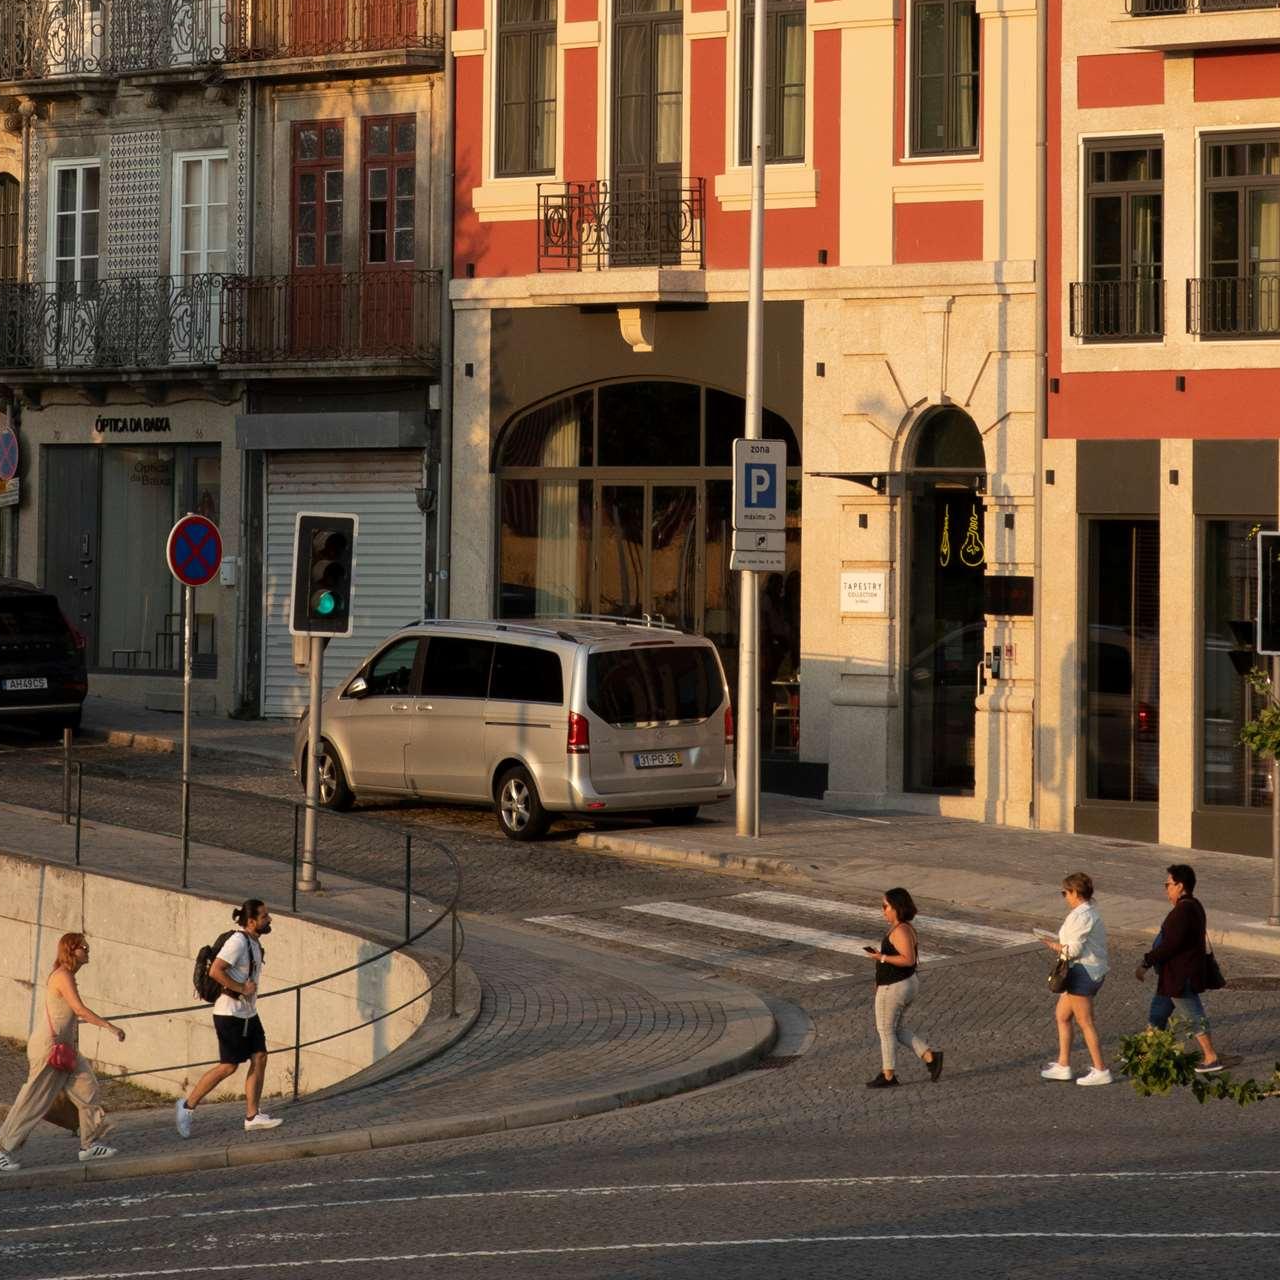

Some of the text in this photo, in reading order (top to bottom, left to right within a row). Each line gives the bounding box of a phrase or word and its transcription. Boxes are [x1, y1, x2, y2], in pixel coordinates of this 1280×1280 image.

[95, 415, 171, 433] ÓPTICA DA BAIXA
[750, 445, 770, 453] zona
[751, 469, 770, 504] P
[843, 582, 882, 590] TAPESTRY
